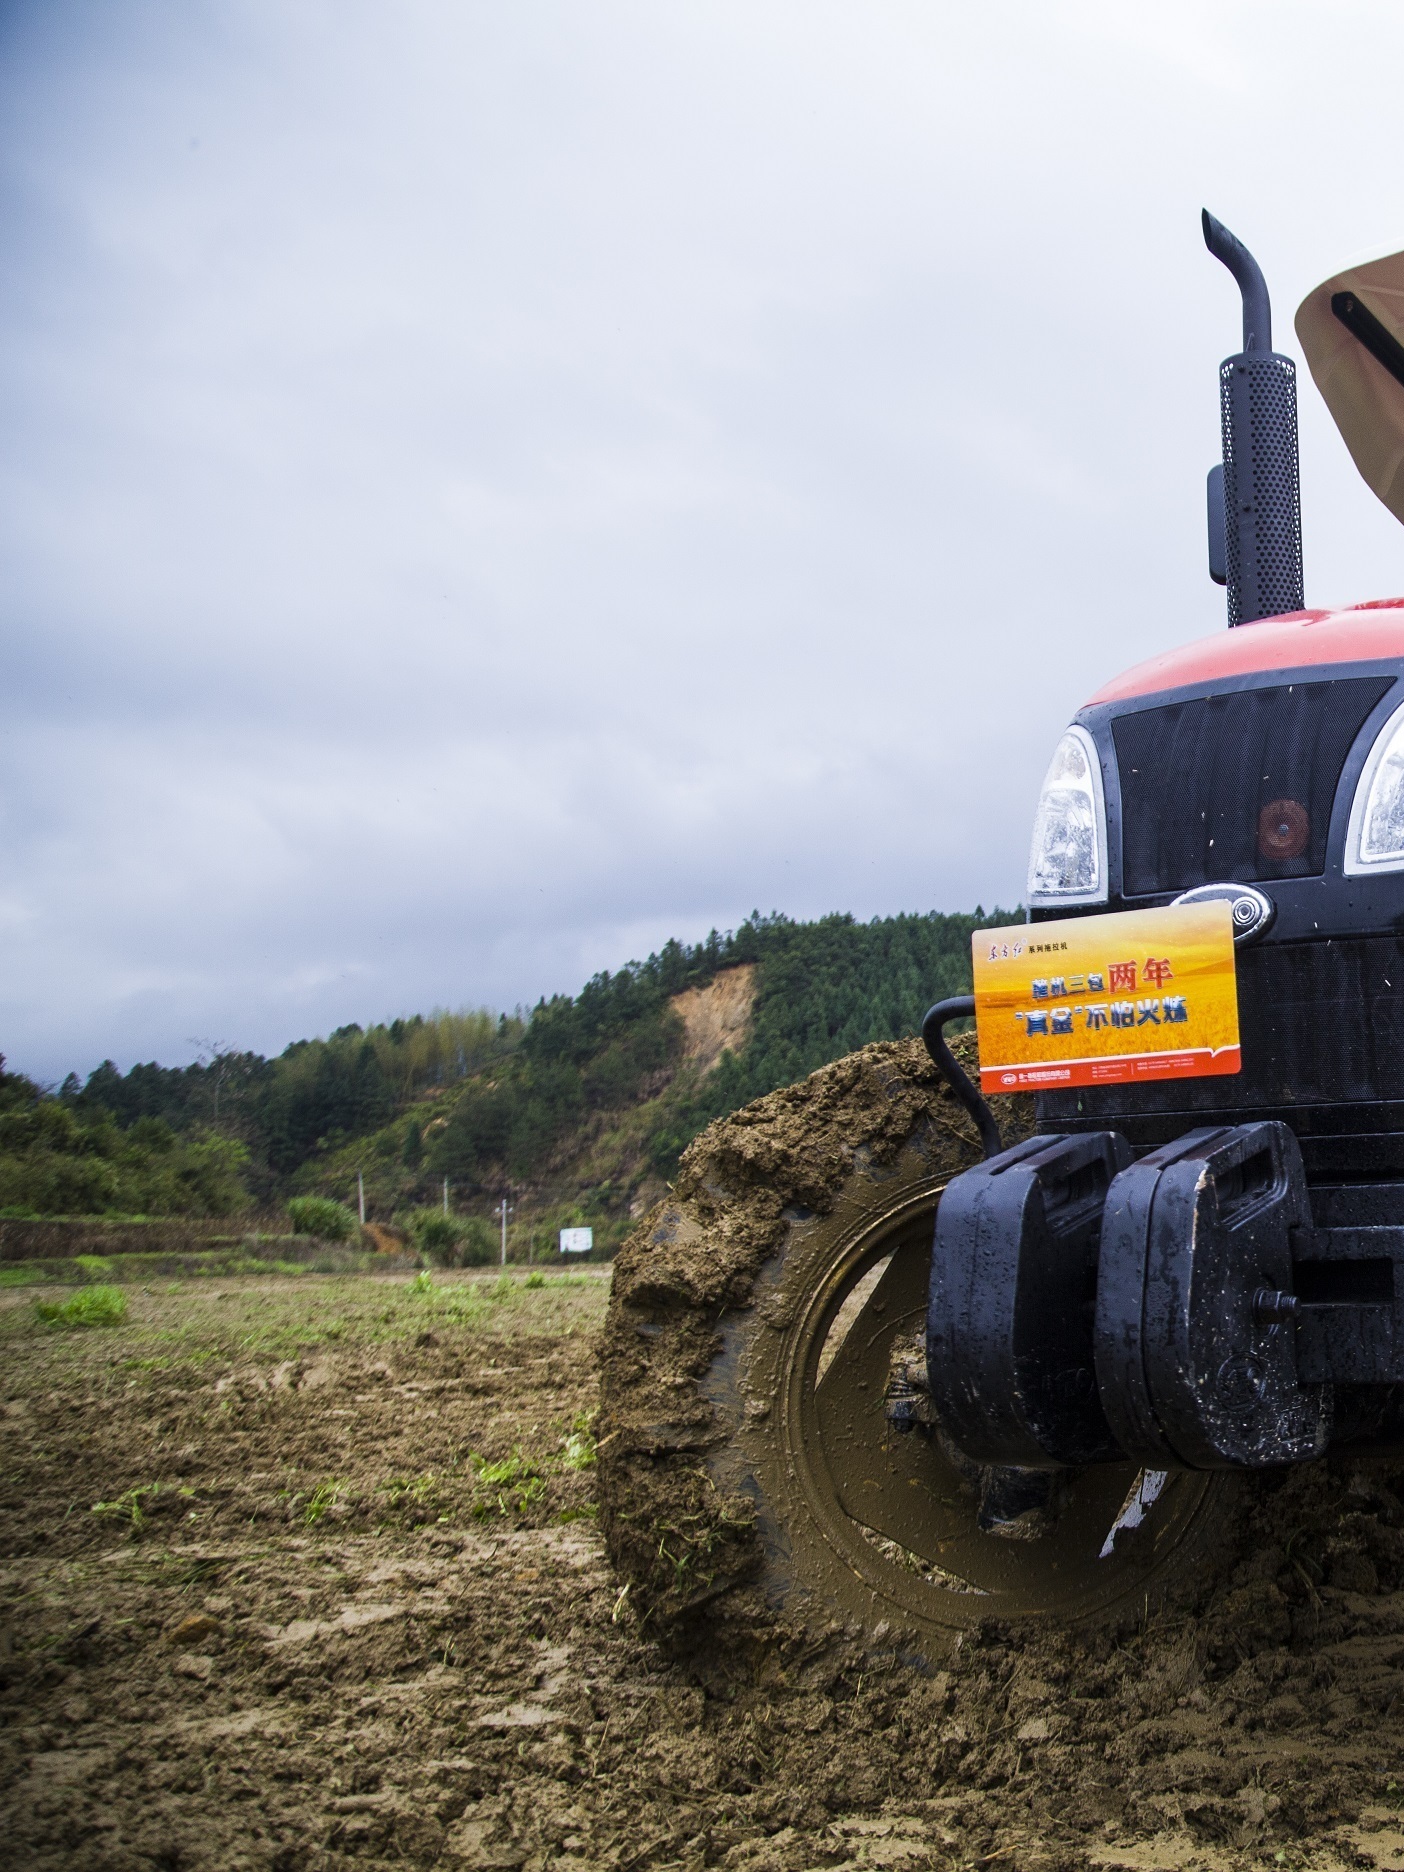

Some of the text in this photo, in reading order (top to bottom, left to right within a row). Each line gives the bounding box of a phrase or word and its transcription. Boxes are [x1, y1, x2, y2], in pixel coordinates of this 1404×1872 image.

[1028, 941, 1068, 954] 系列拖拉机
